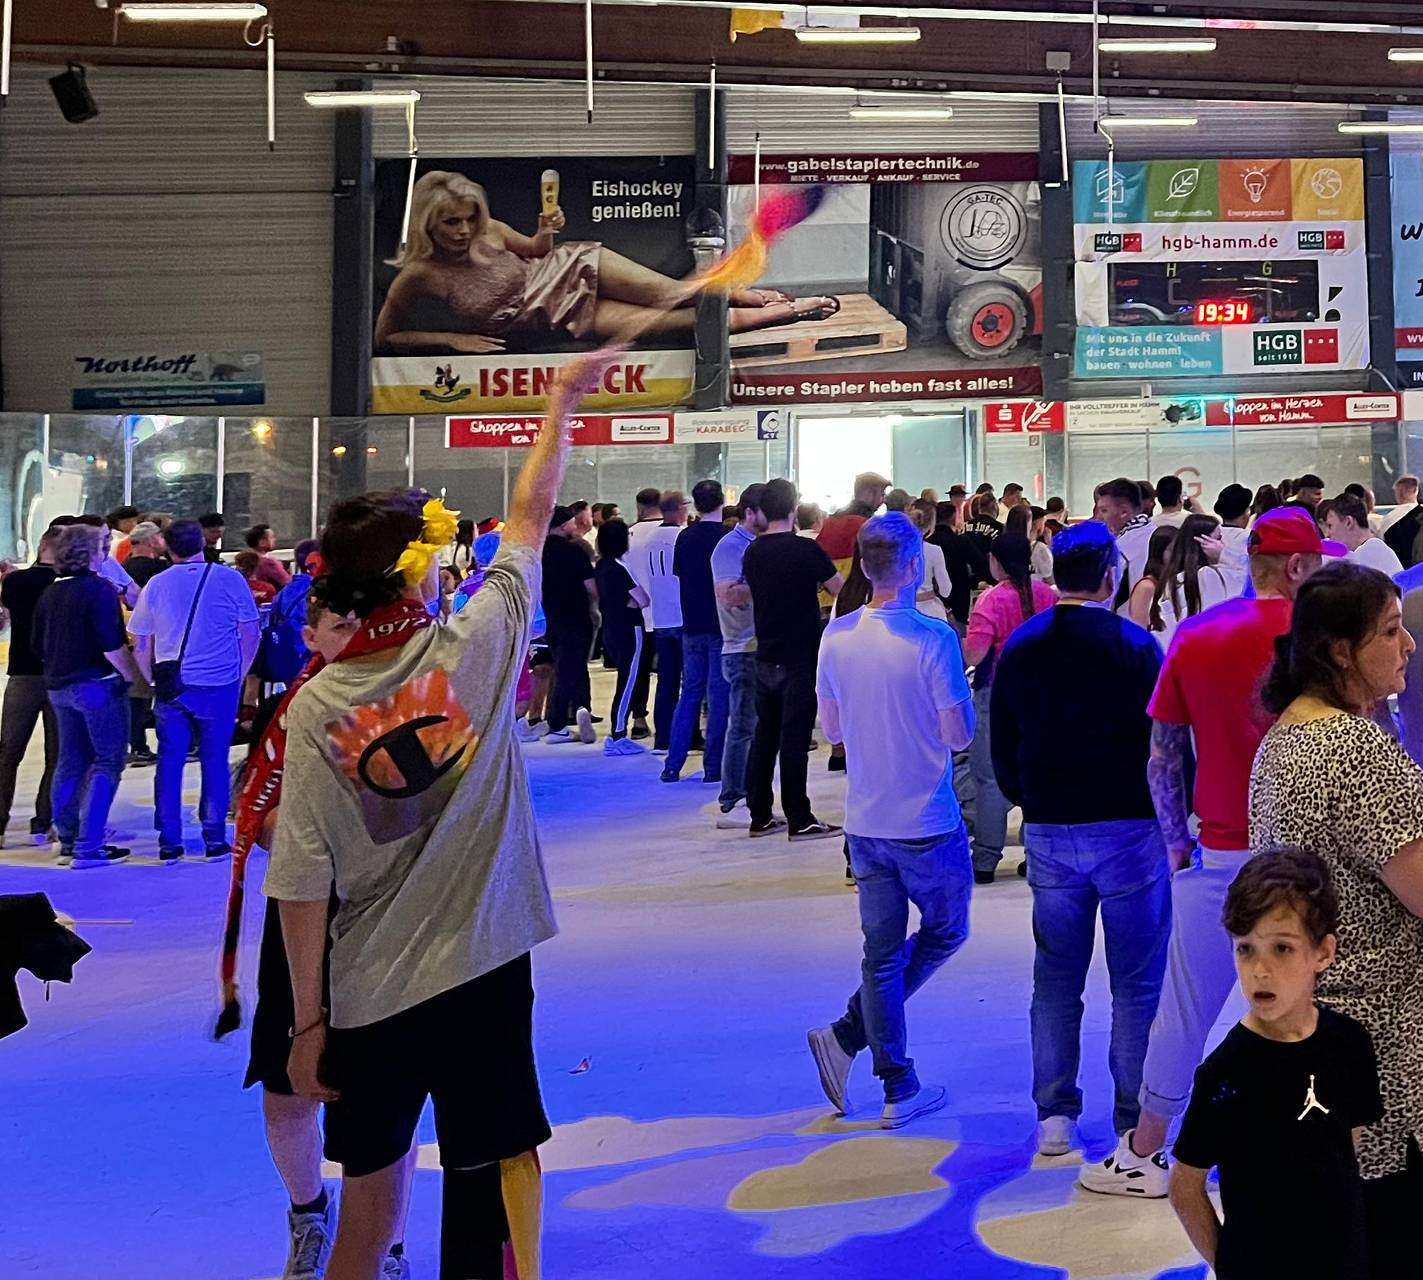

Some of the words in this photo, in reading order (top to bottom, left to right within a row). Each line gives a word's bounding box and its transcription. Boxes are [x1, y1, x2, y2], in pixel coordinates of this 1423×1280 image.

[592, 180, 683, 198] Eishockey
[592, 202, 681, 222] genießen!
[1096, 234, 1120, 245] HGB
[1162, 234, 1279, 252] hgb-hamm.de
[1300, 232, 1323, 243] HGB
[1166, 262, 1177, 278] H
[1262, 260, 1273, 275] G
[1199, 302, 1249, 322] 19:34
[1108, 334, 1129, 343] uns
[1131, 333, 1142, 343] in
[1144, 333, 1163, 343] die
[1166, 331, 1212, 343] Zukunft
[1257, 335, 1298, 350] HGB
[1086, 348, 1105, 357] der
[1107, 347, 1140, 357] Stadt
[1258, 354, 1276, 362] seit
[1086, 360, 1121, 370] bauen
[1128, 359, 1172, 370] wohnen
[479, 364, 648, 397] ISENCK
[733, 382, 795, 397] Unsere
[800, 380, 865, 397] Stapler
[869, 379, 923, 393] heben
[927, 378, 962, 392] fast
[966, 376, 1013, 391] alles!
